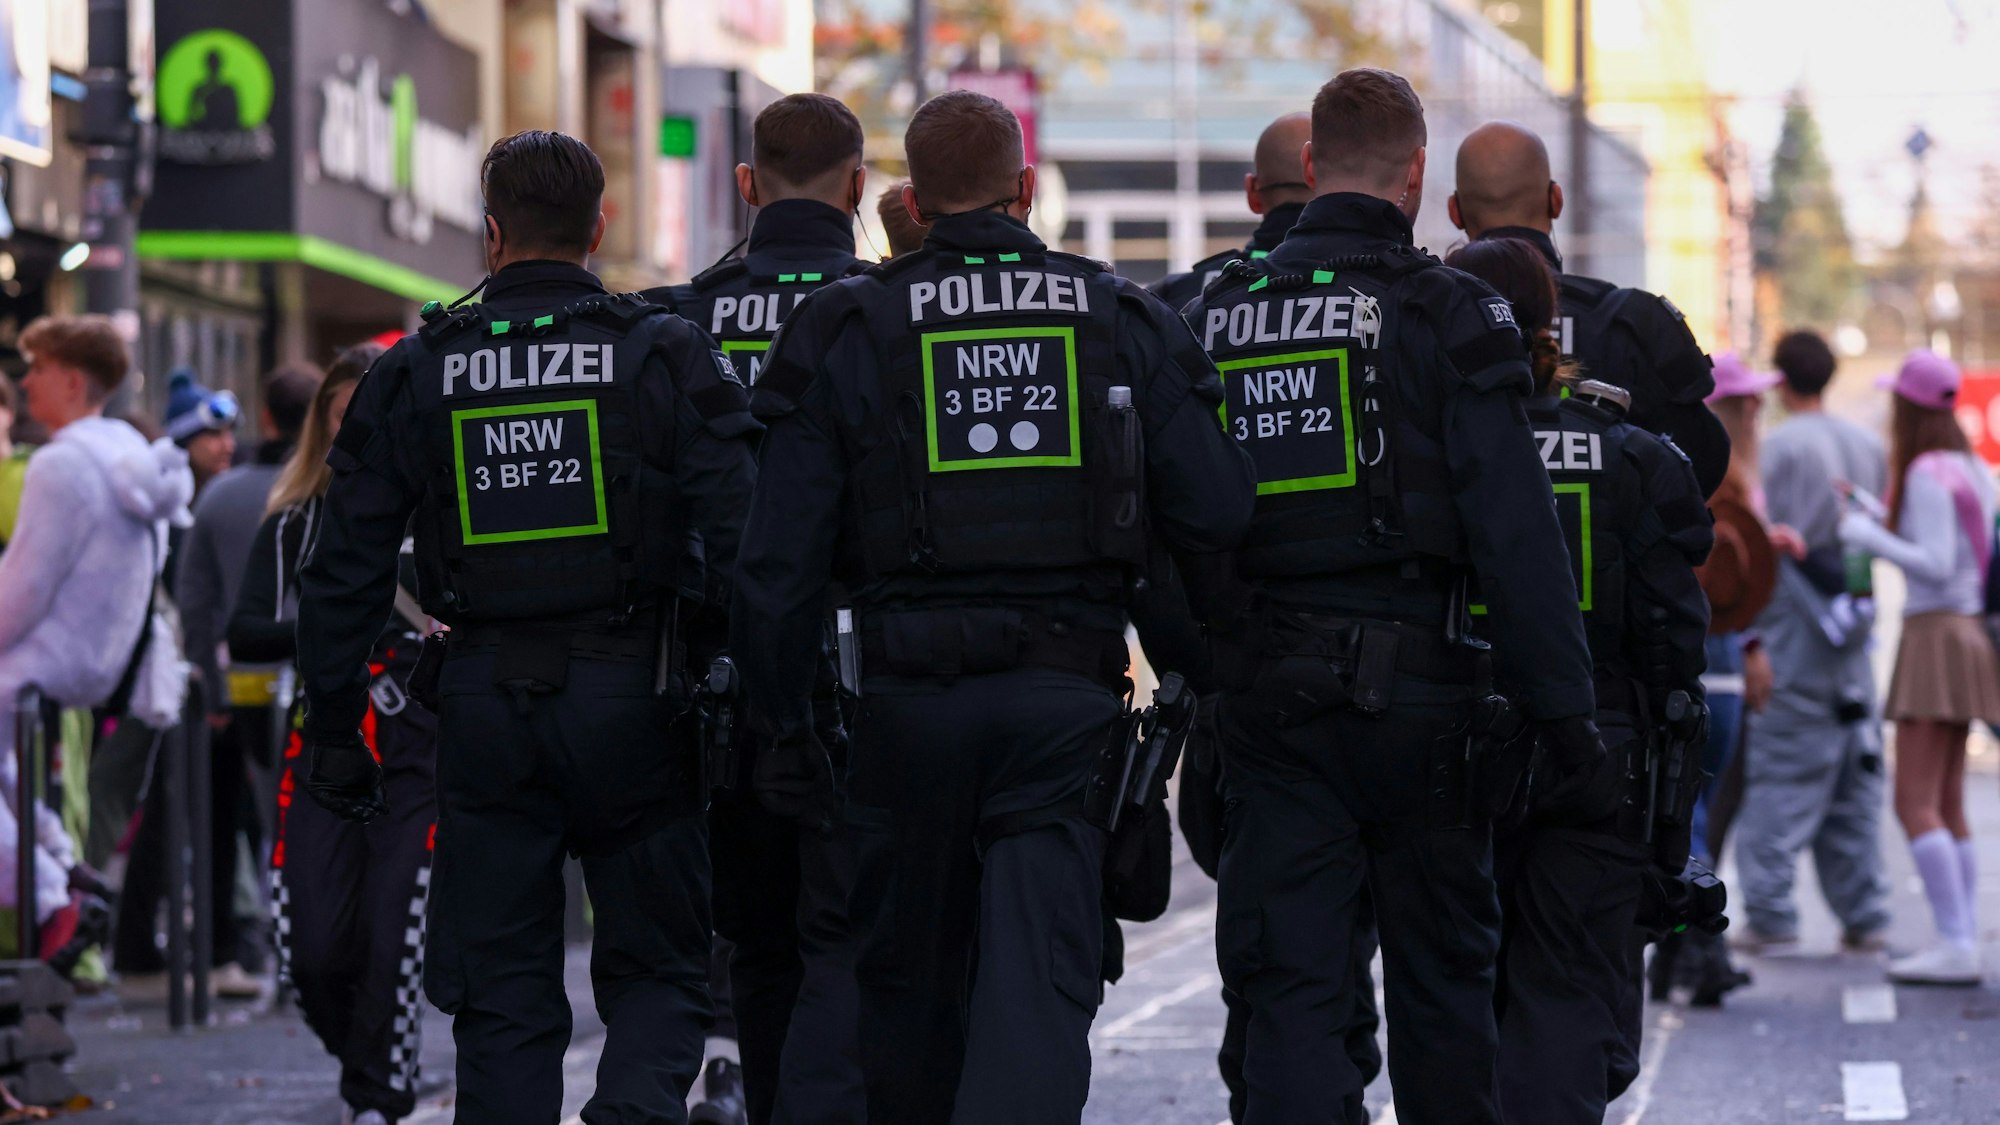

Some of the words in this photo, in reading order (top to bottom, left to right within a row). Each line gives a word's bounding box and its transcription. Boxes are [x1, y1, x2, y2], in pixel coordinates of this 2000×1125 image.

[711, 293, 806, 334] POL
[909, 271, 1090, 322] POLIZEI
[442, 343, 614, 396] POLIZEI
[956, 342, 1041, 380] NRW
[945, 389, 962, 416] 3
[972, 386, 1013, 413] BF
[1023, 385, 1058, 411] 22
[1243, 366, 1317, 406] NRW
[484, 417, 564, 456] NRW
[1234, 416, 1249, 441] 3
[1256, 410, 1292, 439] BF
[1300, 406, 1333, 434] 22
[474, 466, 492, 491] 3
[500, 461, 538, 489] BF
[547, 458, 583, 485] 22
